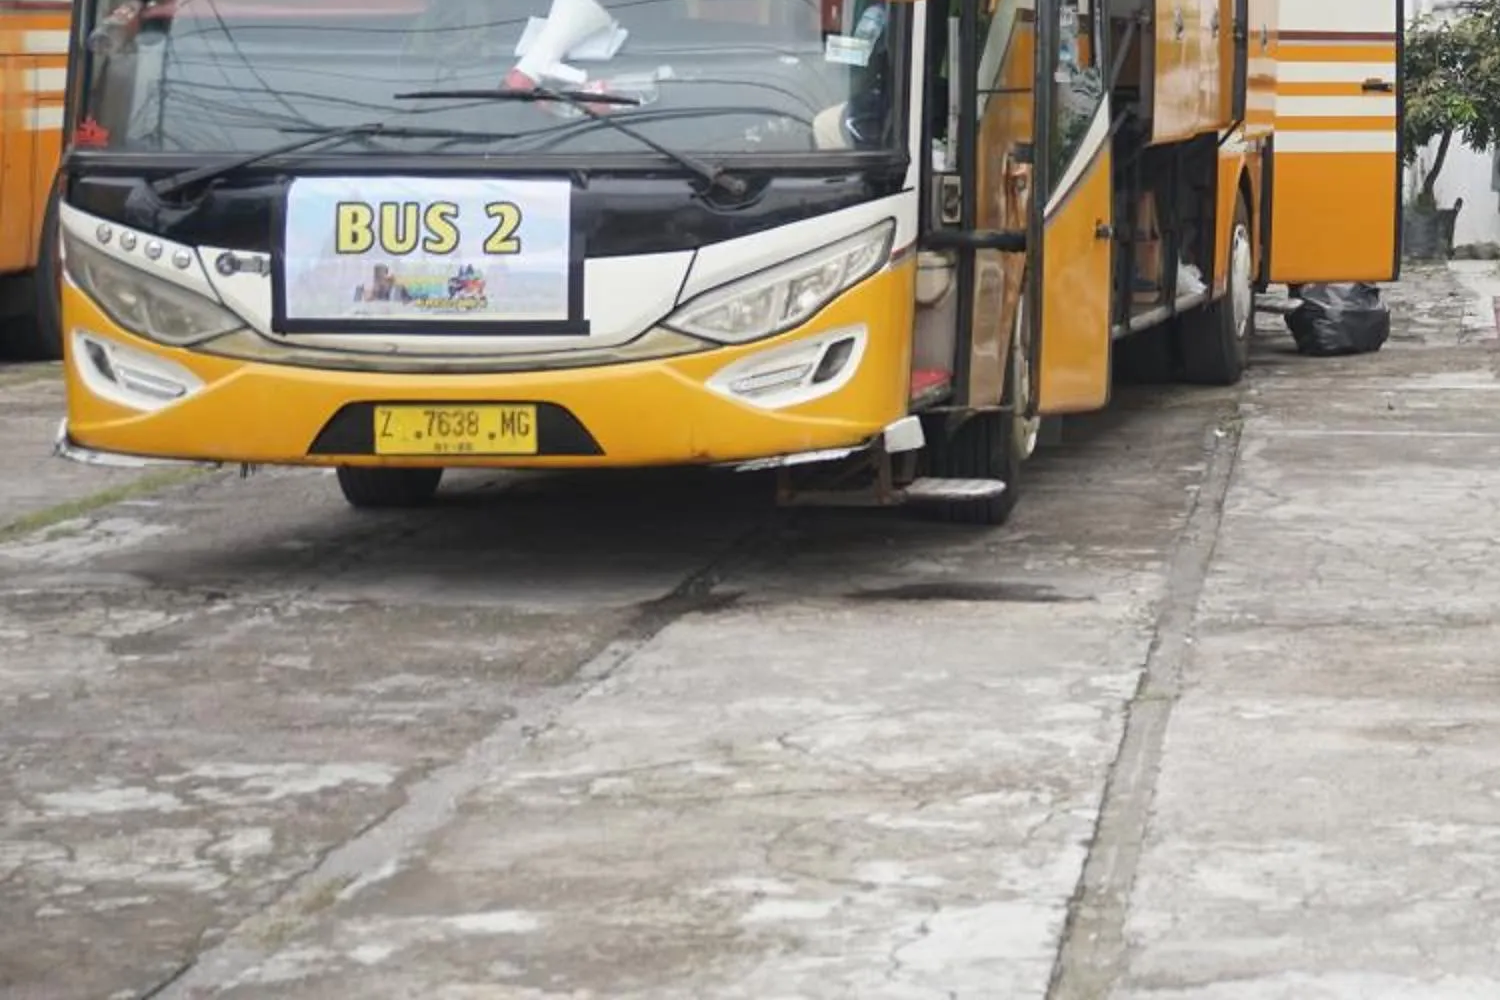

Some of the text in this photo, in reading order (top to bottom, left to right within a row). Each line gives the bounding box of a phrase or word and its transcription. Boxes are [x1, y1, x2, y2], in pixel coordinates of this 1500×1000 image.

[336, 201, 522, 256] BUS 2
[380, 410, 394, 438] Z
